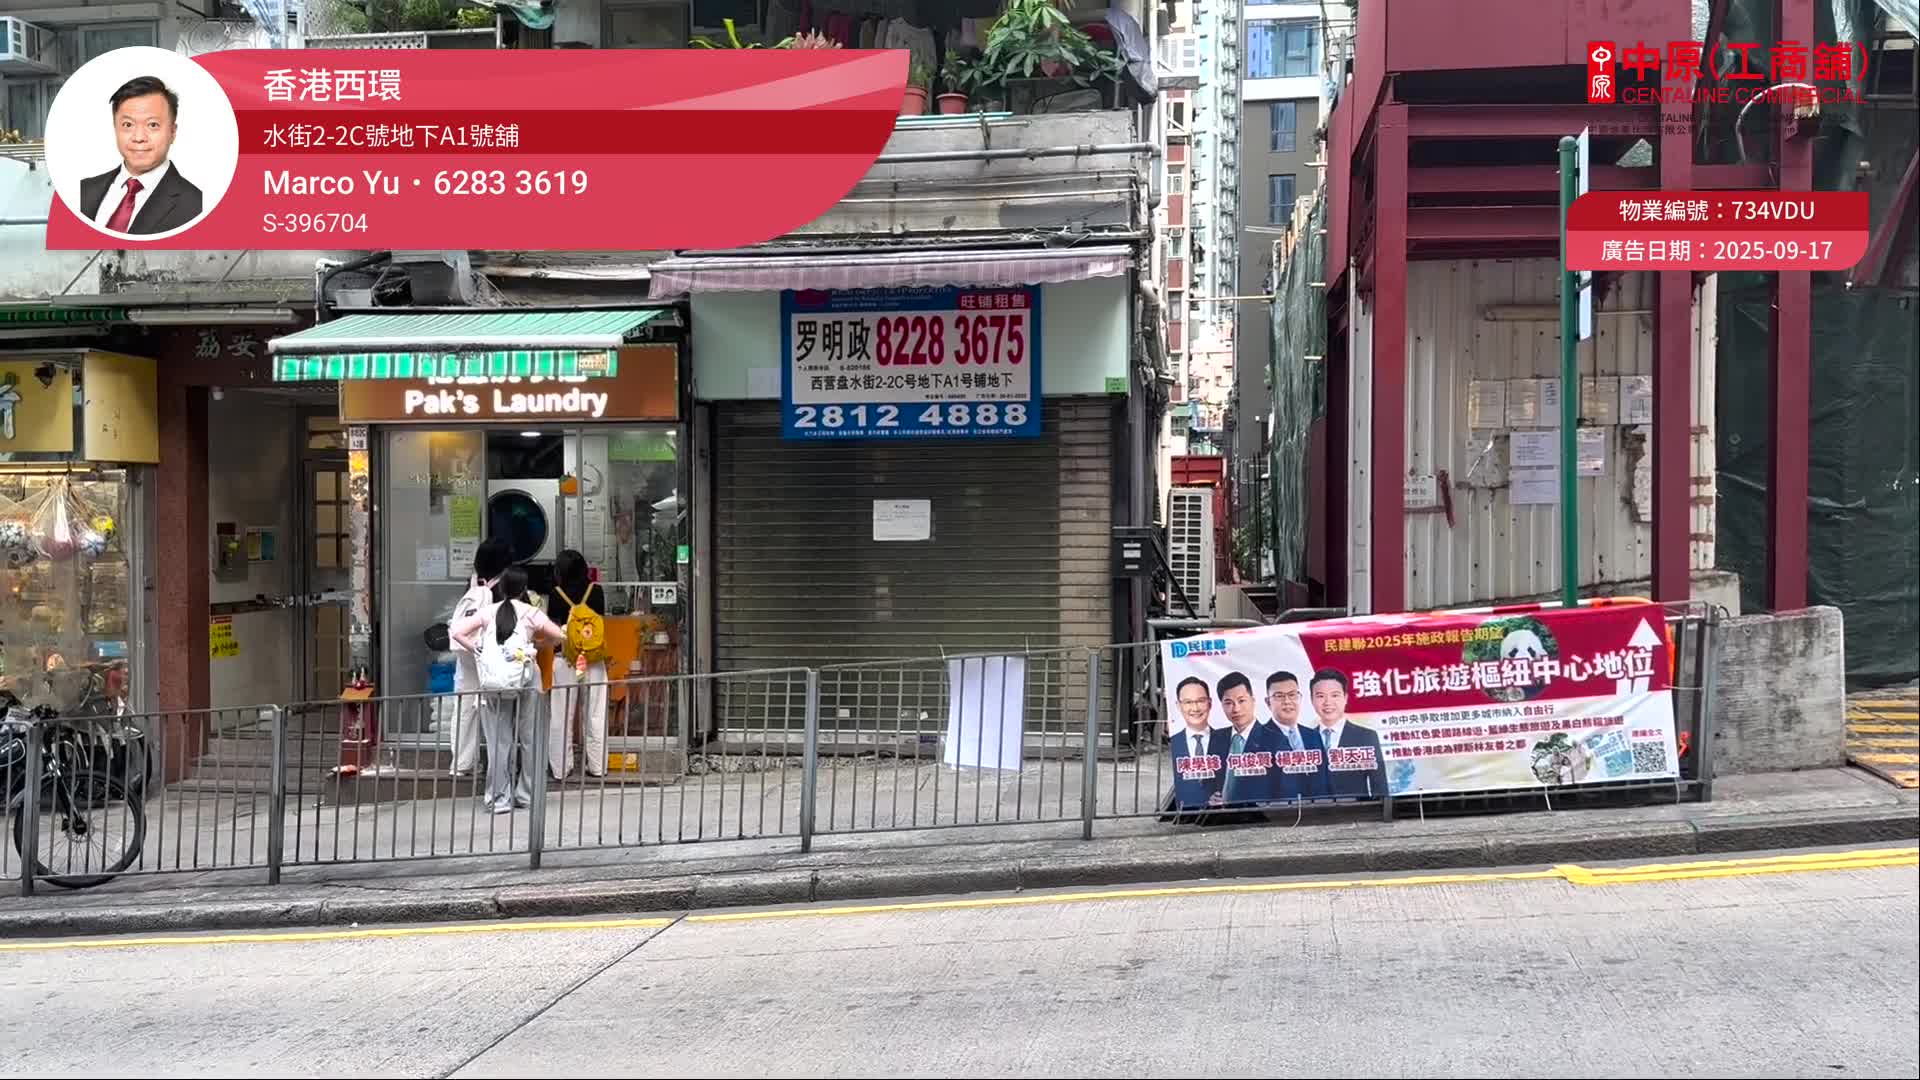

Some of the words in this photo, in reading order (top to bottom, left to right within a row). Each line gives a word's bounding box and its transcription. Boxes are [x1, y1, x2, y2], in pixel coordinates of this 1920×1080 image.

[796, 317, 872, 362] 罗明政
[876, 315, 945, 366] 8228
[954, 314, 1025, 364] 3675
[810, 372, 1014, 390] 西营盘水街2-2C号地下A1号铺地下
[405, 389, 480, 415] Pak's
[493, 387, 608, 418] Laundry
[794, 405, 900, 428] 2812
[918, 403, 1029, 427] 4888
[1324, 625, 1504, 653] 民建聯2025年施政報告期望
[1352, 648, 1655, 699] 強化旅遊樞紐中心地位
[1227, 753, 1272, 769] 何俊賢
[1276, 749, 1322, 766] 楊學明
[1329, 746, 1377, 764] 劉天正
